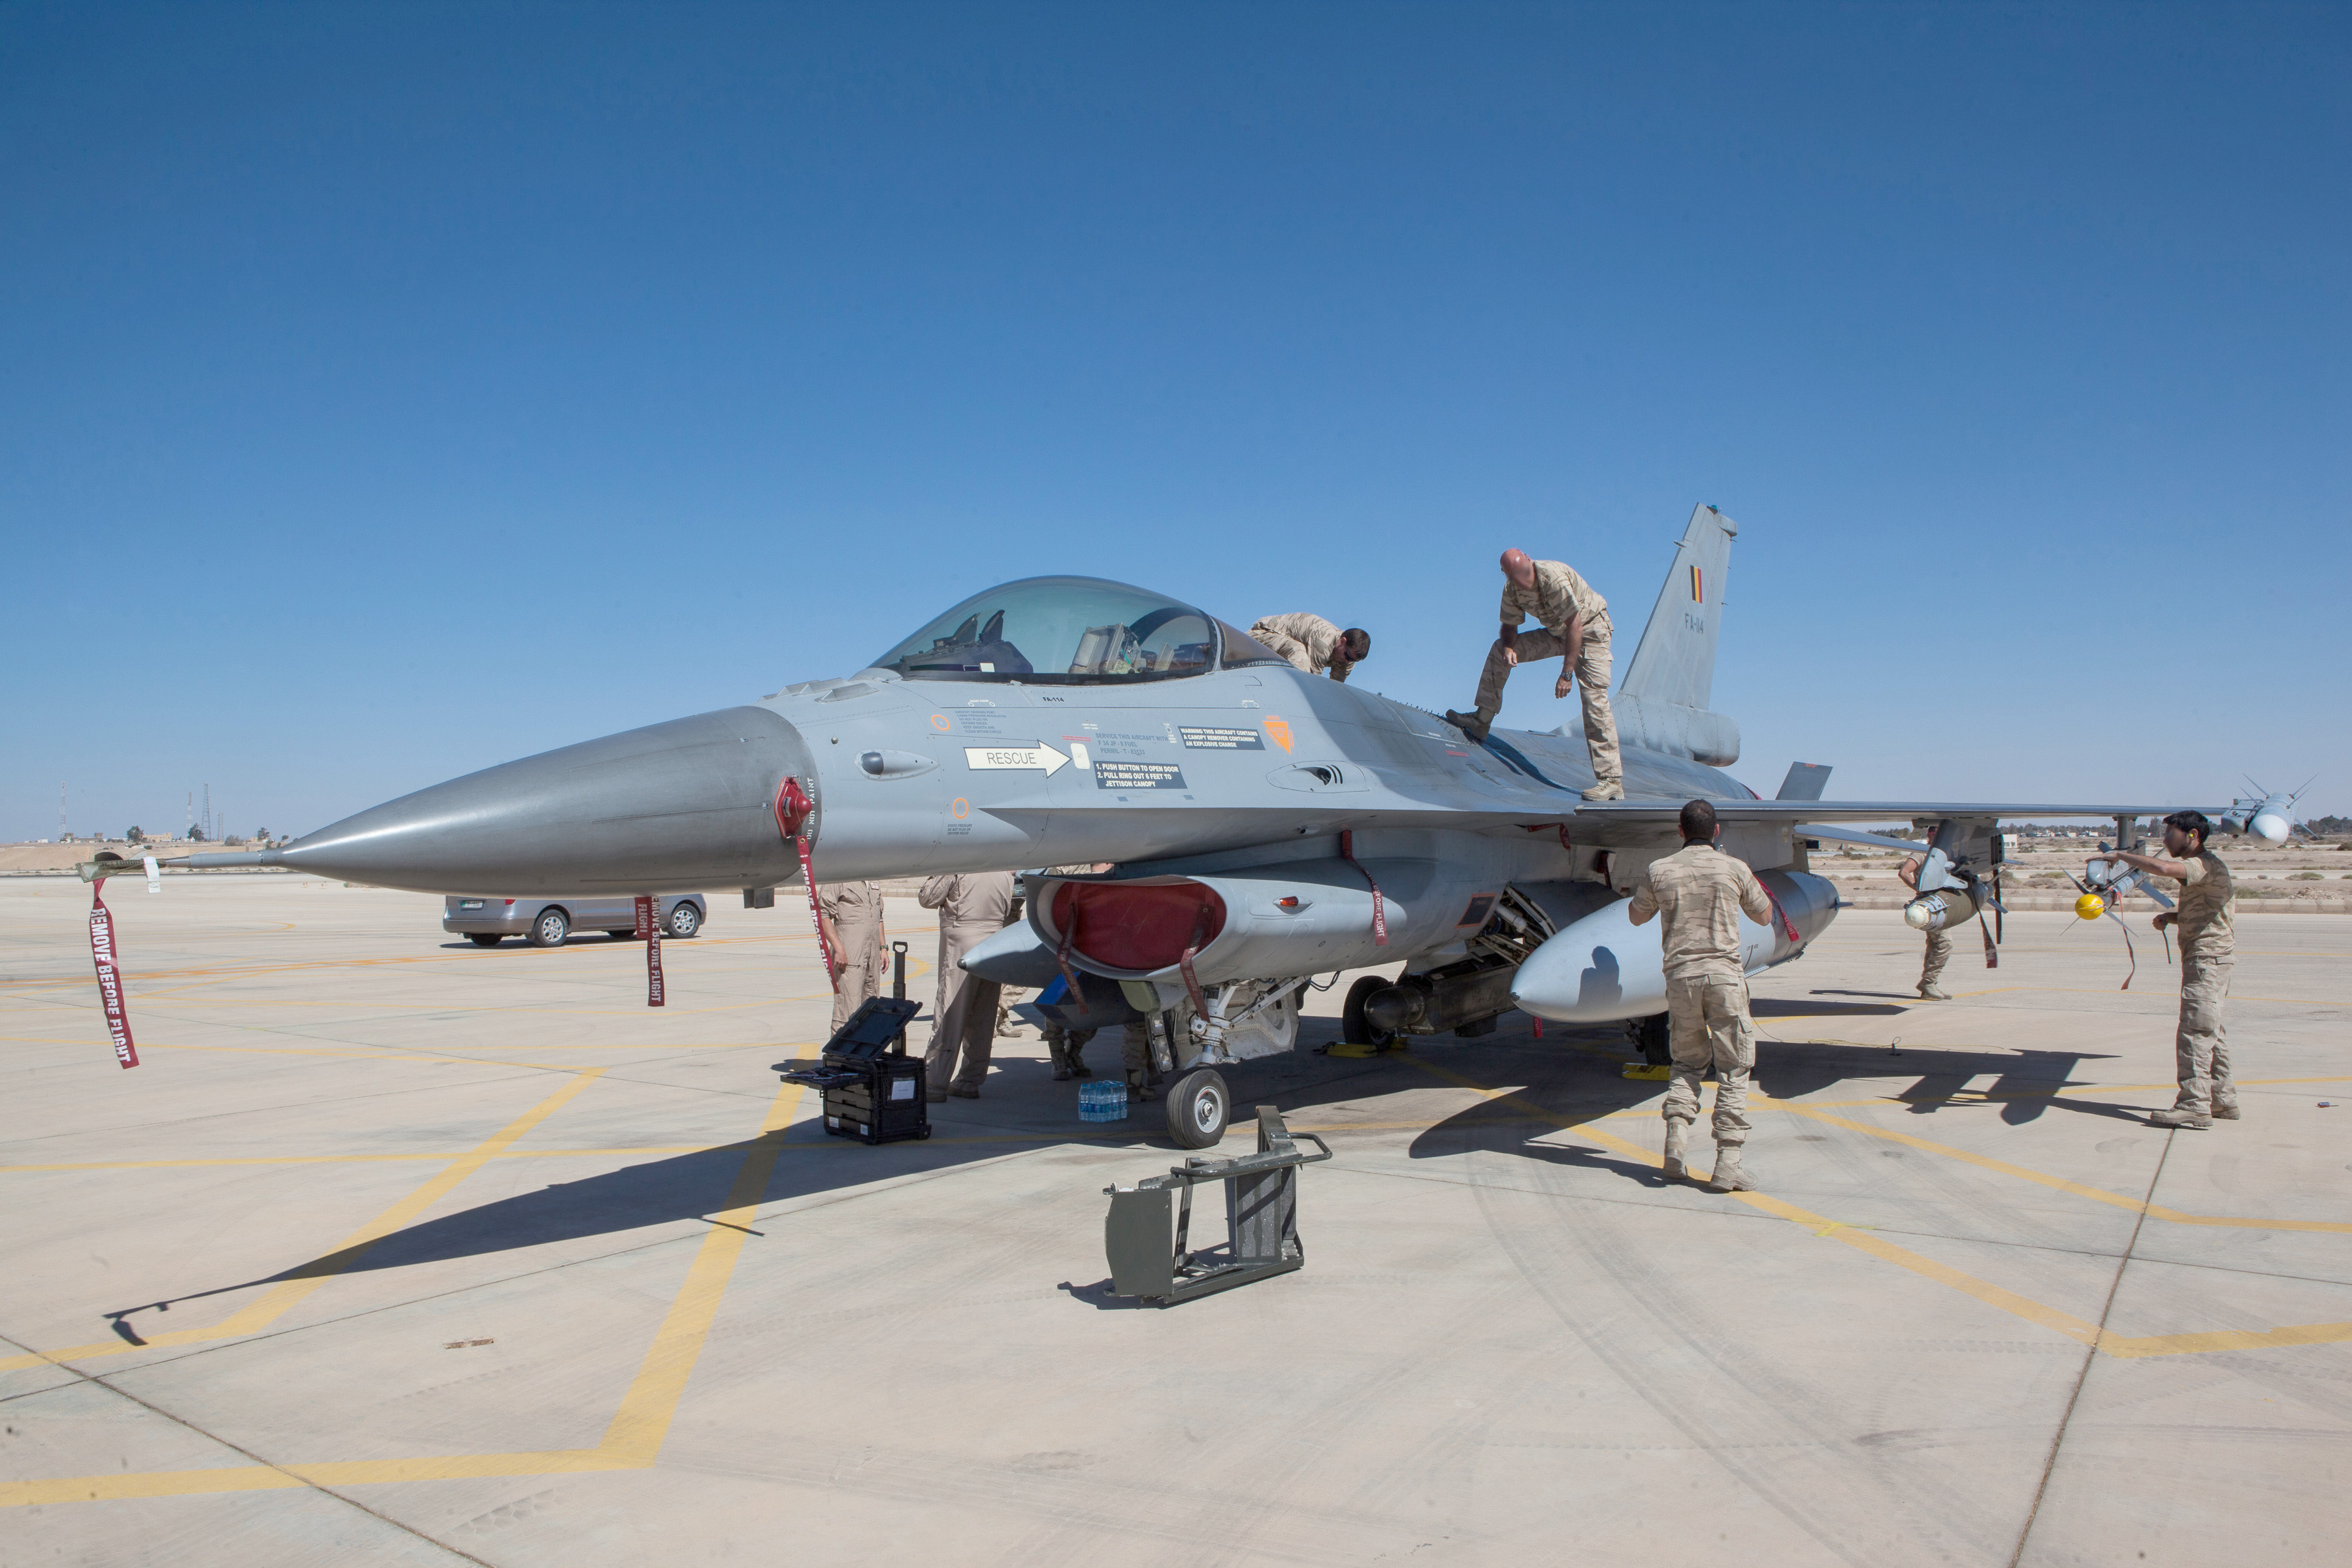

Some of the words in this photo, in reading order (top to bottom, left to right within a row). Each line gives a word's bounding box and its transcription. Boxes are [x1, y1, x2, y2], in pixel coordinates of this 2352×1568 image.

[1685, 613, 1704, 634] FA-114
[987, 753, 1036, 764] RESCUE
[807, 777, 815, 804] PAINT
[807, 829, 813, 840] DO
[651, 896, 660, 928] EMOVE
[1376, 913, 1385, 937] FLIGHT
[90, 907, 112, 962] REMOVE
[1784, 917, 1796, 935] FLIGHT
[651, 932, 660, 967] BEFORE
[98, 965, 120, 1015] BEFORE
[651, 970, 661, 1002] FLIGHT
[1185, 970, 1199, 992] BEFORE
[110, 1019, 131, 1062] FLIGHT
